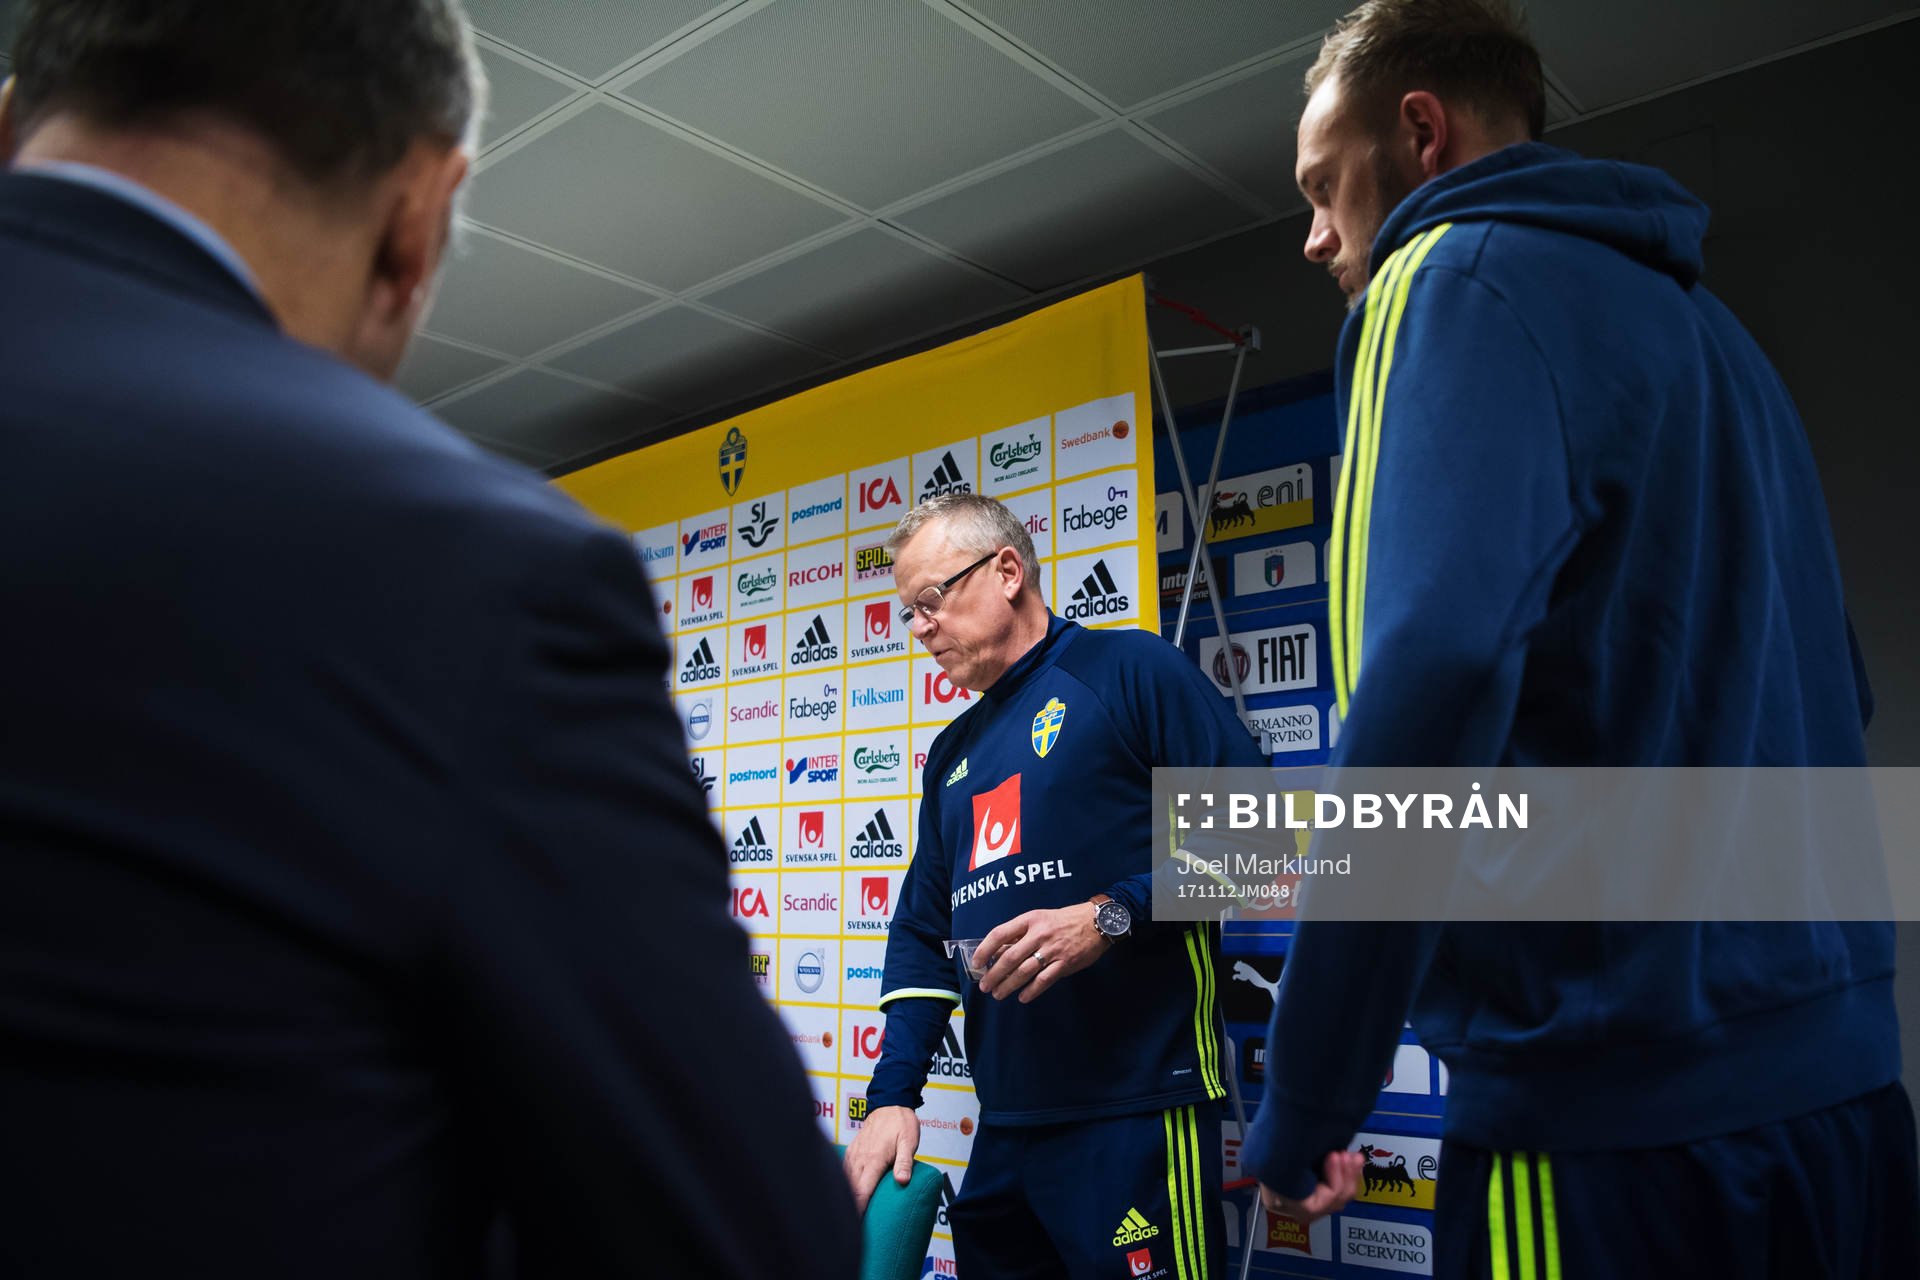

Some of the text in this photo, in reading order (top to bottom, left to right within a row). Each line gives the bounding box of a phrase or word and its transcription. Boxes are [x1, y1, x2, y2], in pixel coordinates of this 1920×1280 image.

[1061, 427, 1111, 449] Swedbank
[990, 440, 1041, 468] Carlsberg
[859, 476, 902, 513] ICA
[1257, 468, 1303, 509] eni
[751, 502, 766, 523] SJ
[792, 497, 842, 524] postnord
[1063, 503, 1128, 532] Fabege
[700, 523, 727, 540] INTER
[638, 545, 674, 562] olksam
[700, 535, 726, 552] SPORT
[856, 546, 894, 571] SPOR
[789, 562, 843, 587] RICOH
[858, 566, 892, 579] BLADE
[738, 573, 776, 594] Carlsberg
[1065, 595, 1129, 620] adidas
[681, 611, 723, 626] SVENSKA SPEL
[791, 645, 838, 665] adidas
[851, 642, 905, 658] SVENSKA SPEL
[1258, 633, 1309, 684] FIAT
[680, 664, 721, 683] adidas
[732, 662, 778, 677] SVENSKA SPEL
[852, 688, 904, 708] Folksam
[730, 702, 778, 722] Scandic
[789, 698, 837, 721] Fabege
[1270, 729, 1313, 743] RVINO
[808, 755, 838, 768] INTER
[854, 747, 900, 770] Carlsberg
[729, 767, 777, 784] postnord
[808, 768, 838, 783] SPORT
[730, 844, 773, 862] adidas
[785, 852, 838, 863] SVENSKA SPEL
[850, 840, 903, 858] adidas
[951, 859, 1072, 912] SVENSKA SPEL
[733, 888, 770, 918] ICA
[784, 893, 837, 911] Scandic
[847, 921, 882, 930] SVENSKA
[847, 966, 884, 980] postn
[853, 1025, 885, 1059] IC
[929, 1056, 974, 1078] didas
[919, 1118, 959, 1130] wedbank
[1113, 1226, 1159, 1247] adidas
[1277, 1220, 1300, 1233] SAN
[1270, 1231, 1307, 1244] CARLO
[1349, 1227, 1425, 1248] ERMANNO
[1348, 1243, 1426, 1264] SCERVINO
